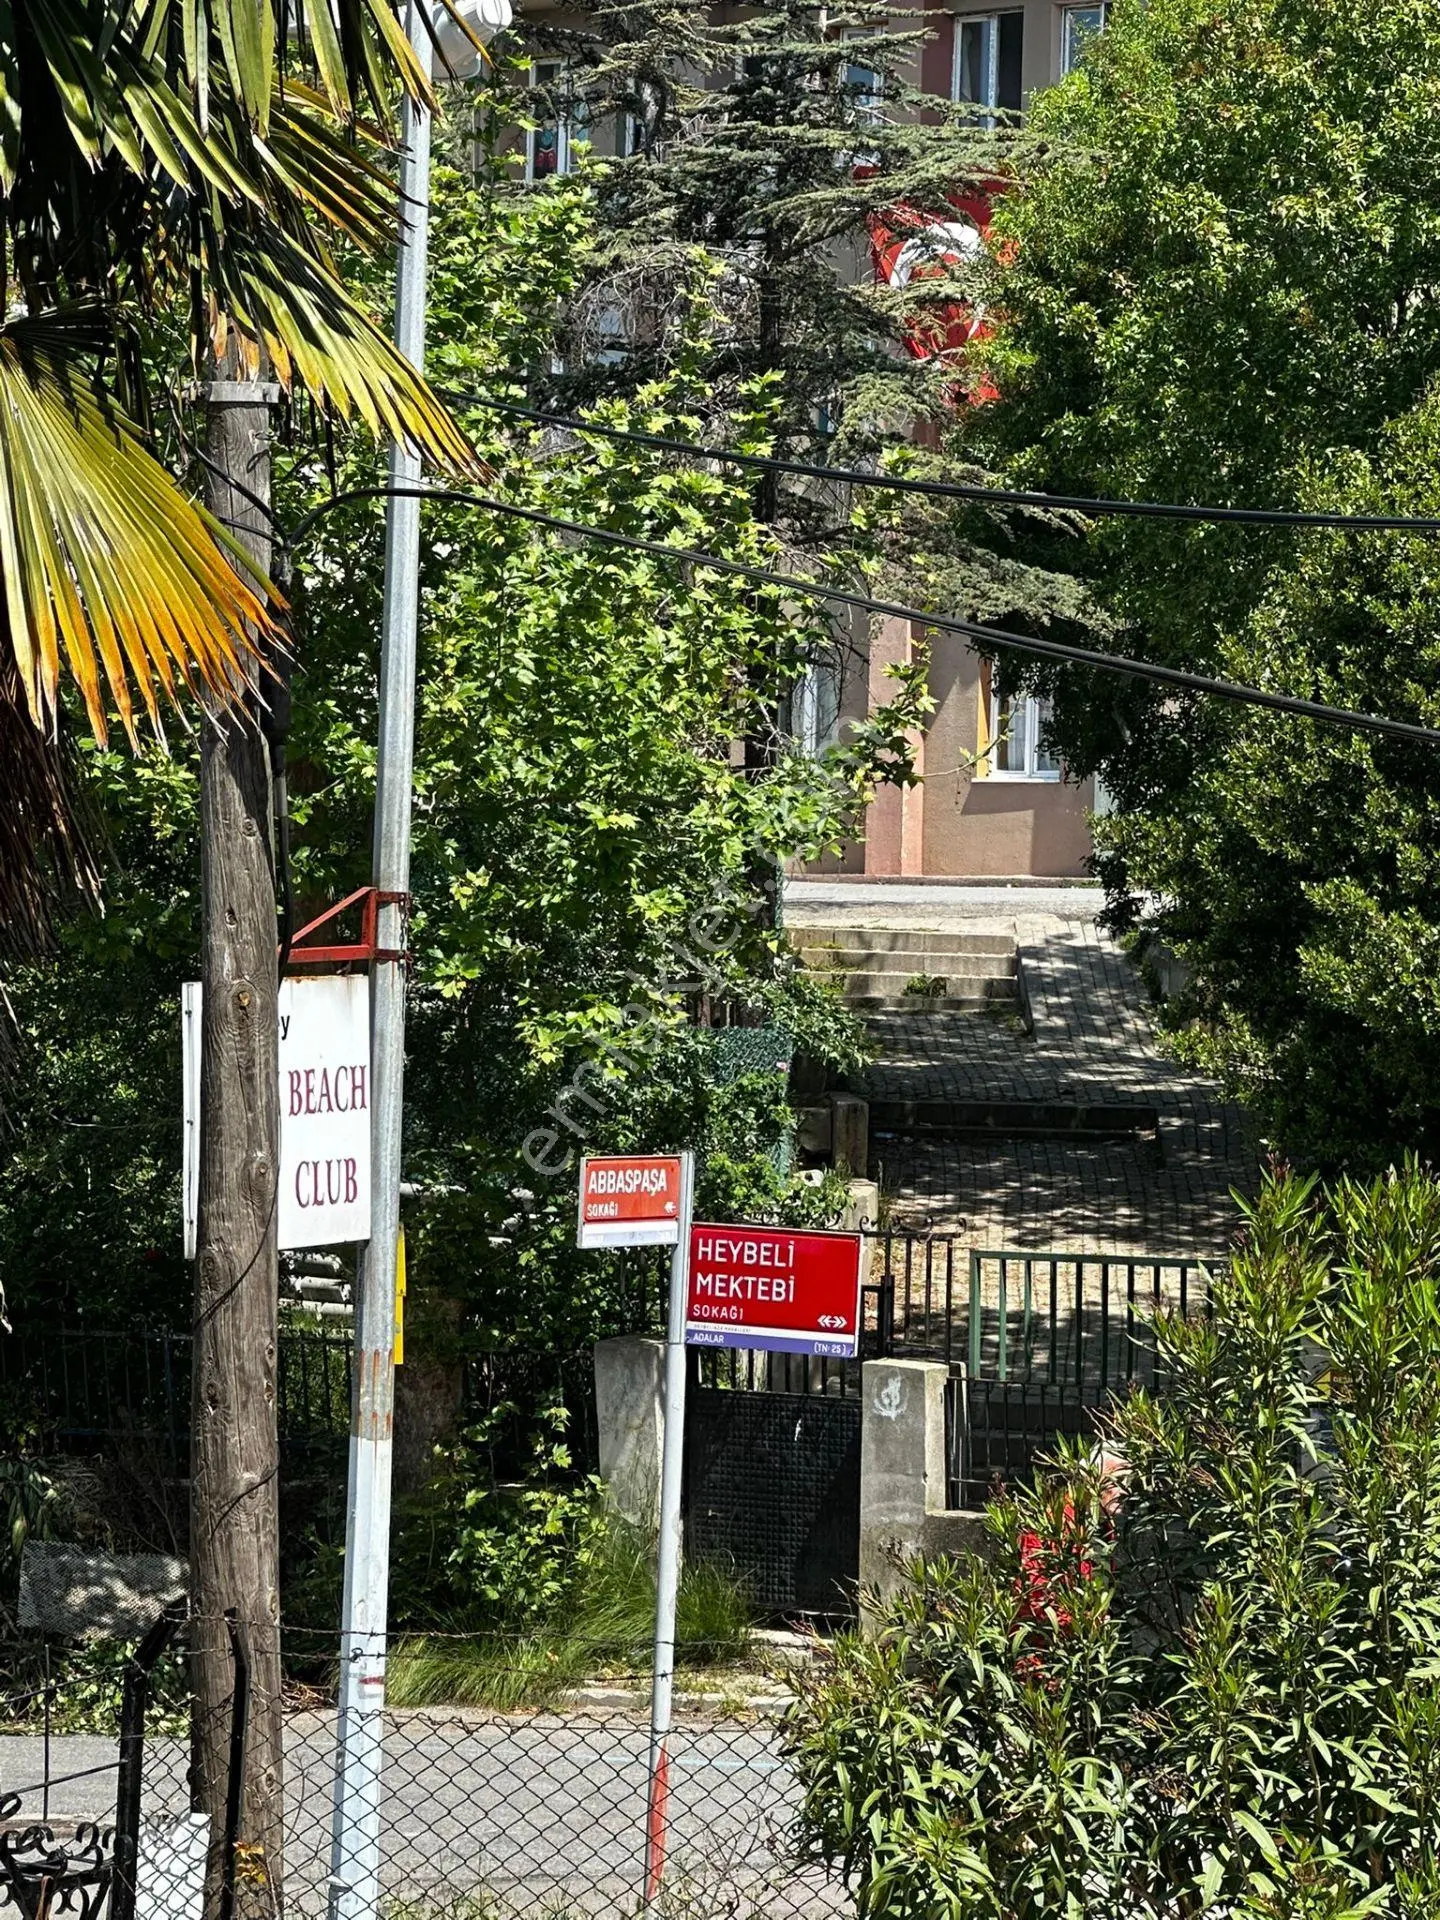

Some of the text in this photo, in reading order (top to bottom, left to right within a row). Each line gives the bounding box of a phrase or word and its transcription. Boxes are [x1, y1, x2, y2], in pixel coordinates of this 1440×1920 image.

[288, 1065, 367, 1117] BEACH
[295, 1158, 358, 1208] CLUB
[587, 1168, 668, 1196] ABBASPAŞA
[586, 1201, 618, 1217] SOKAĞI
[698, 1238, 795, 1268] HEYBELİ
[696, 1272, 795, 1303] MEKTEBİ
[693, 1304, 743, 1320] SOKAĞI
[693, 1333, 724, 1343] ADALAR
